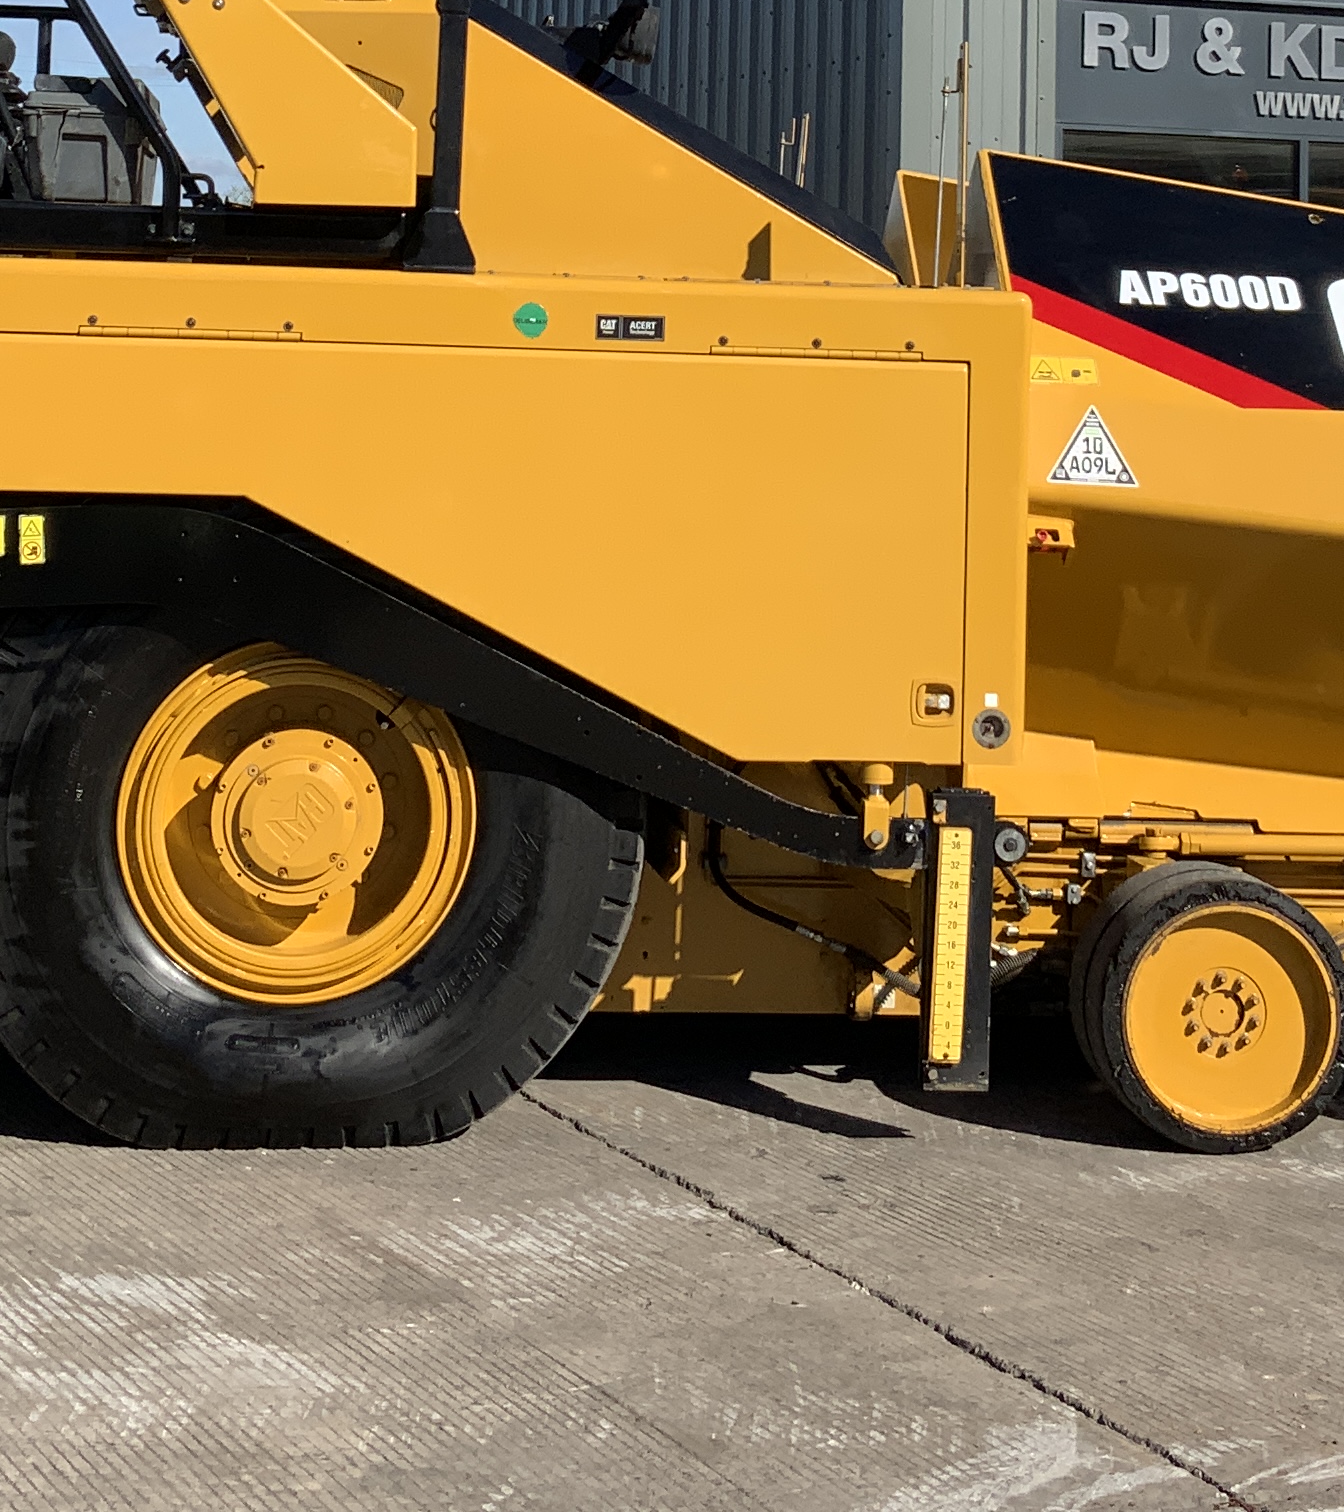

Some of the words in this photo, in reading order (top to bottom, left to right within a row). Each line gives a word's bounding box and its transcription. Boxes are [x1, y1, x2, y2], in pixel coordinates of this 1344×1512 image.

[1082, 10, 1171, 71] RJ
[1196, 17, 1246, 75] &
[1118, 269, 1302, 312] AP600D
[600, 319, 617, 330] CAT
[629, 321, 656, 330] ACERT
[1069, 455, 1117, 476] A09L
[951, 841, 961, 850] 36
[950, 861, 960, 870] 32
[948, 901, 958, 909] 24
[947, 921, 957, 929] 20
[946, 941, 956, 950] 16
[945, 961, 955, 970] 12
[945, 1001, 951, 1009] 4
